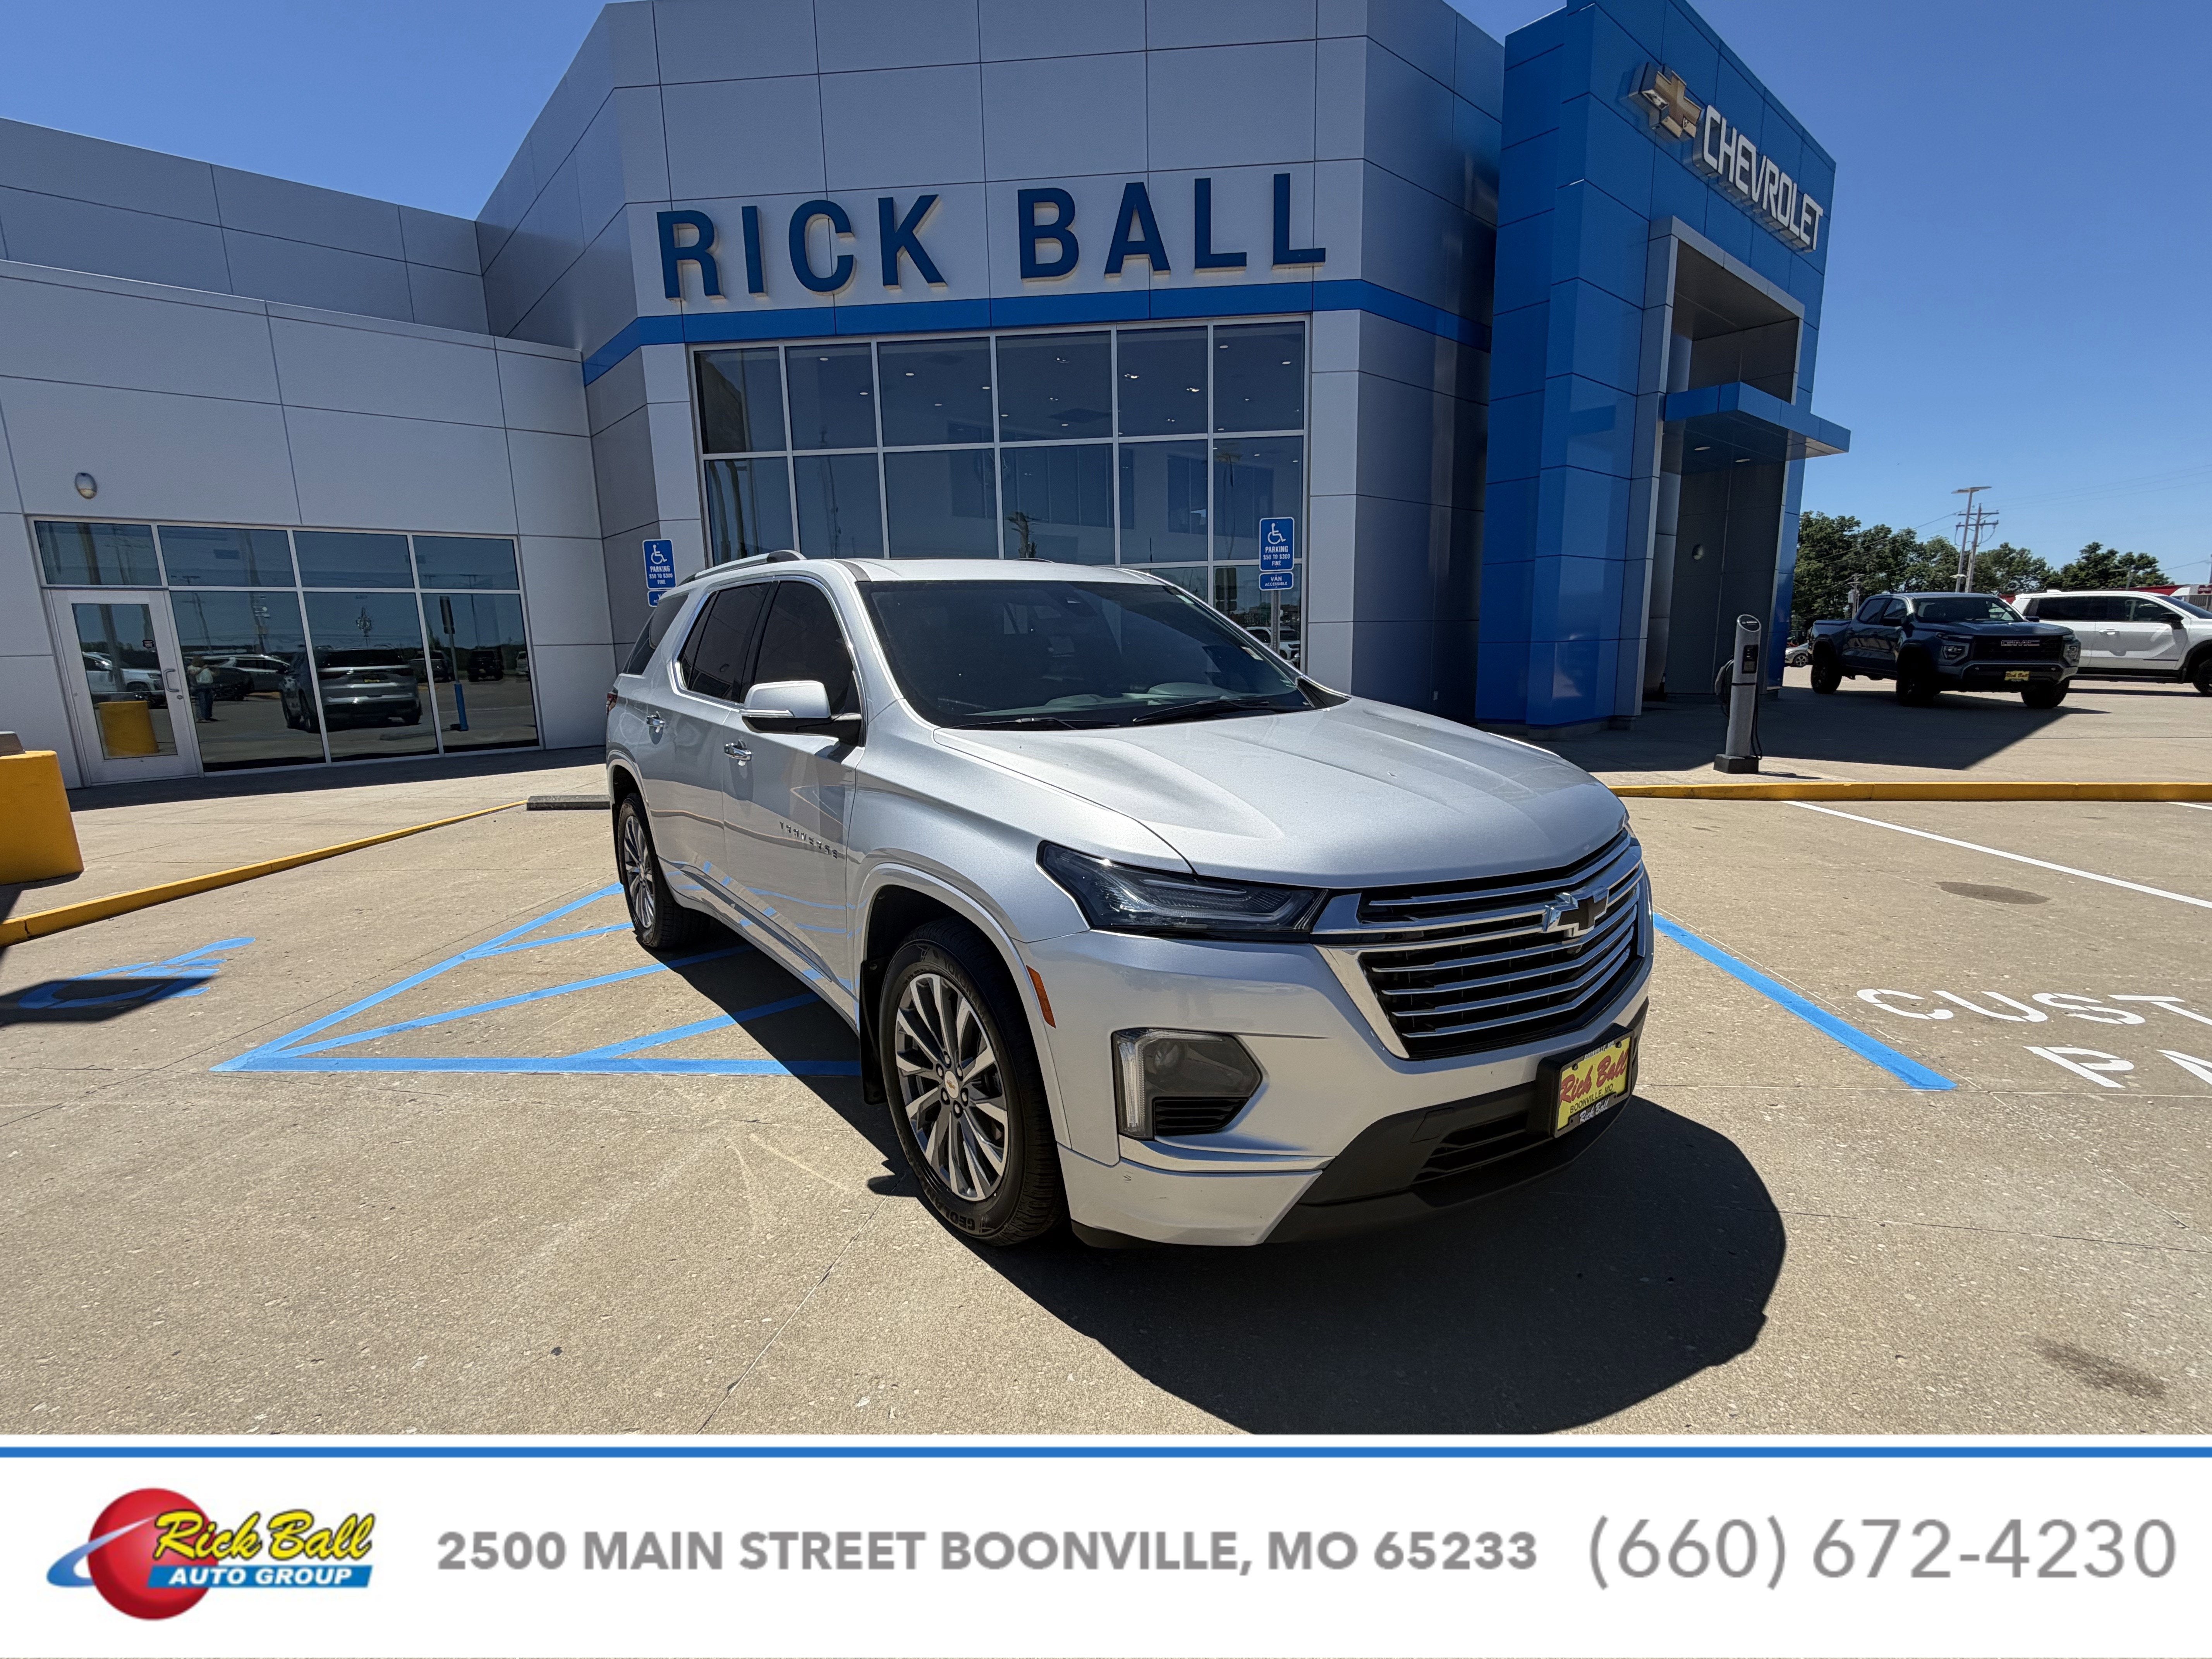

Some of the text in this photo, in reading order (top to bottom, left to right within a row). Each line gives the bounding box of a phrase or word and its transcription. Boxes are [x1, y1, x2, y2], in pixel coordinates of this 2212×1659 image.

[1701, 104, 1823, 252] CHEVROLET
[657, 172, 1327, 301] RICK BALL
[1856, 989, 2212, 1026] CUST
[1560, 1048, 1630, 1103] Rick Ball
[1570, 1084, 1613, 1113] BOONVILLE, MO
[1580, 1098, 1609, 1125] Rick Ball
